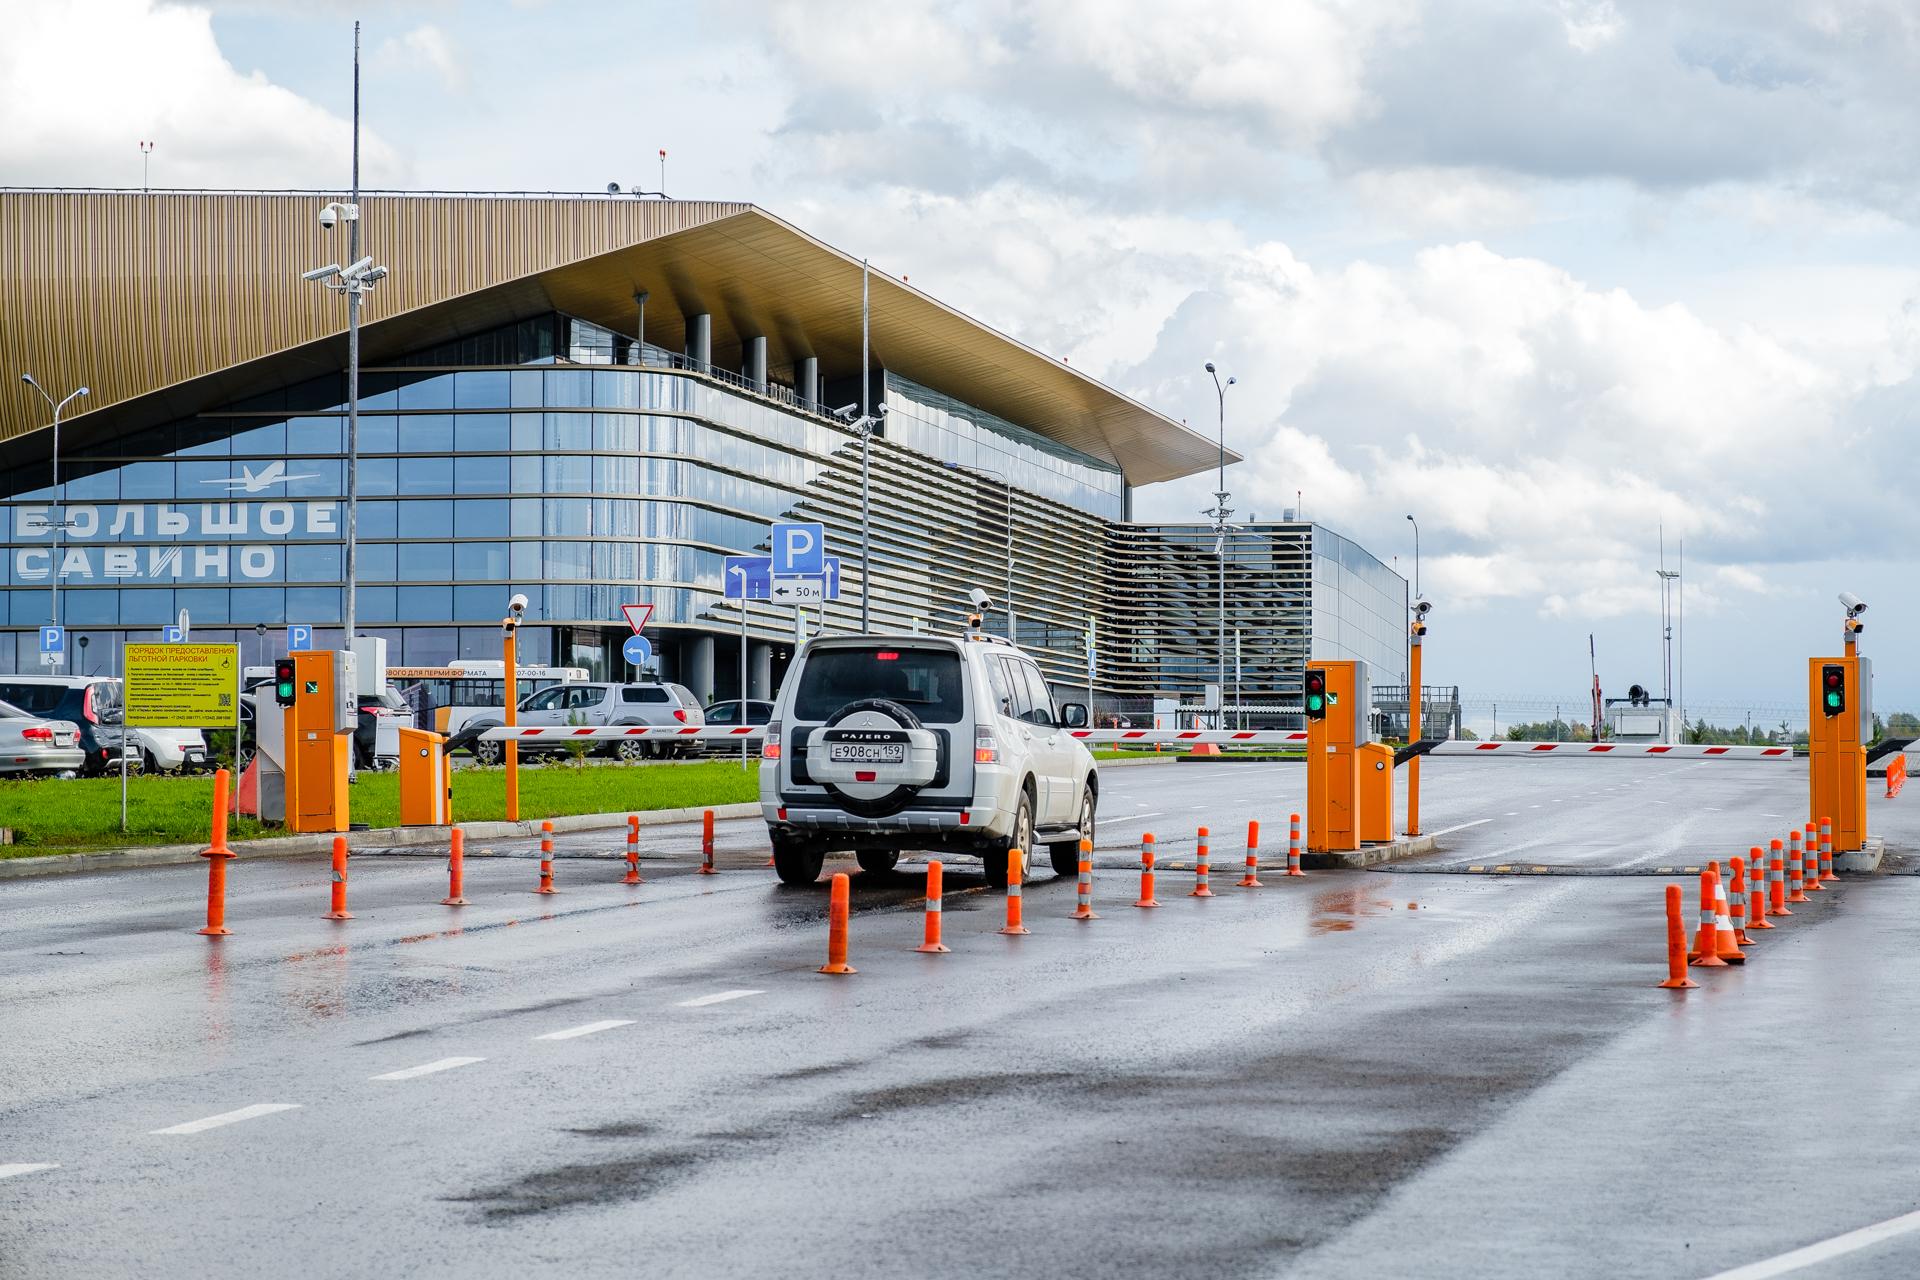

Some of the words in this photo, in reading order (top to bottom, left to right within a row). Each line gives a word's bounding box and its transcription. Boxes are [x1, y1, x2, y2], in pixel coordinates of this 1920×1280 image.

[16, 502, 337, 537] БОЛЬШОЕ
[786, 529, 814, 569] P
[16, 545, 275, 580] САВИНО
[796, 587, 810, 597] 50
[46, 630, 59, 649] P
[294, 628, 308, 648] P
[882, 746, 900, 755] 159
